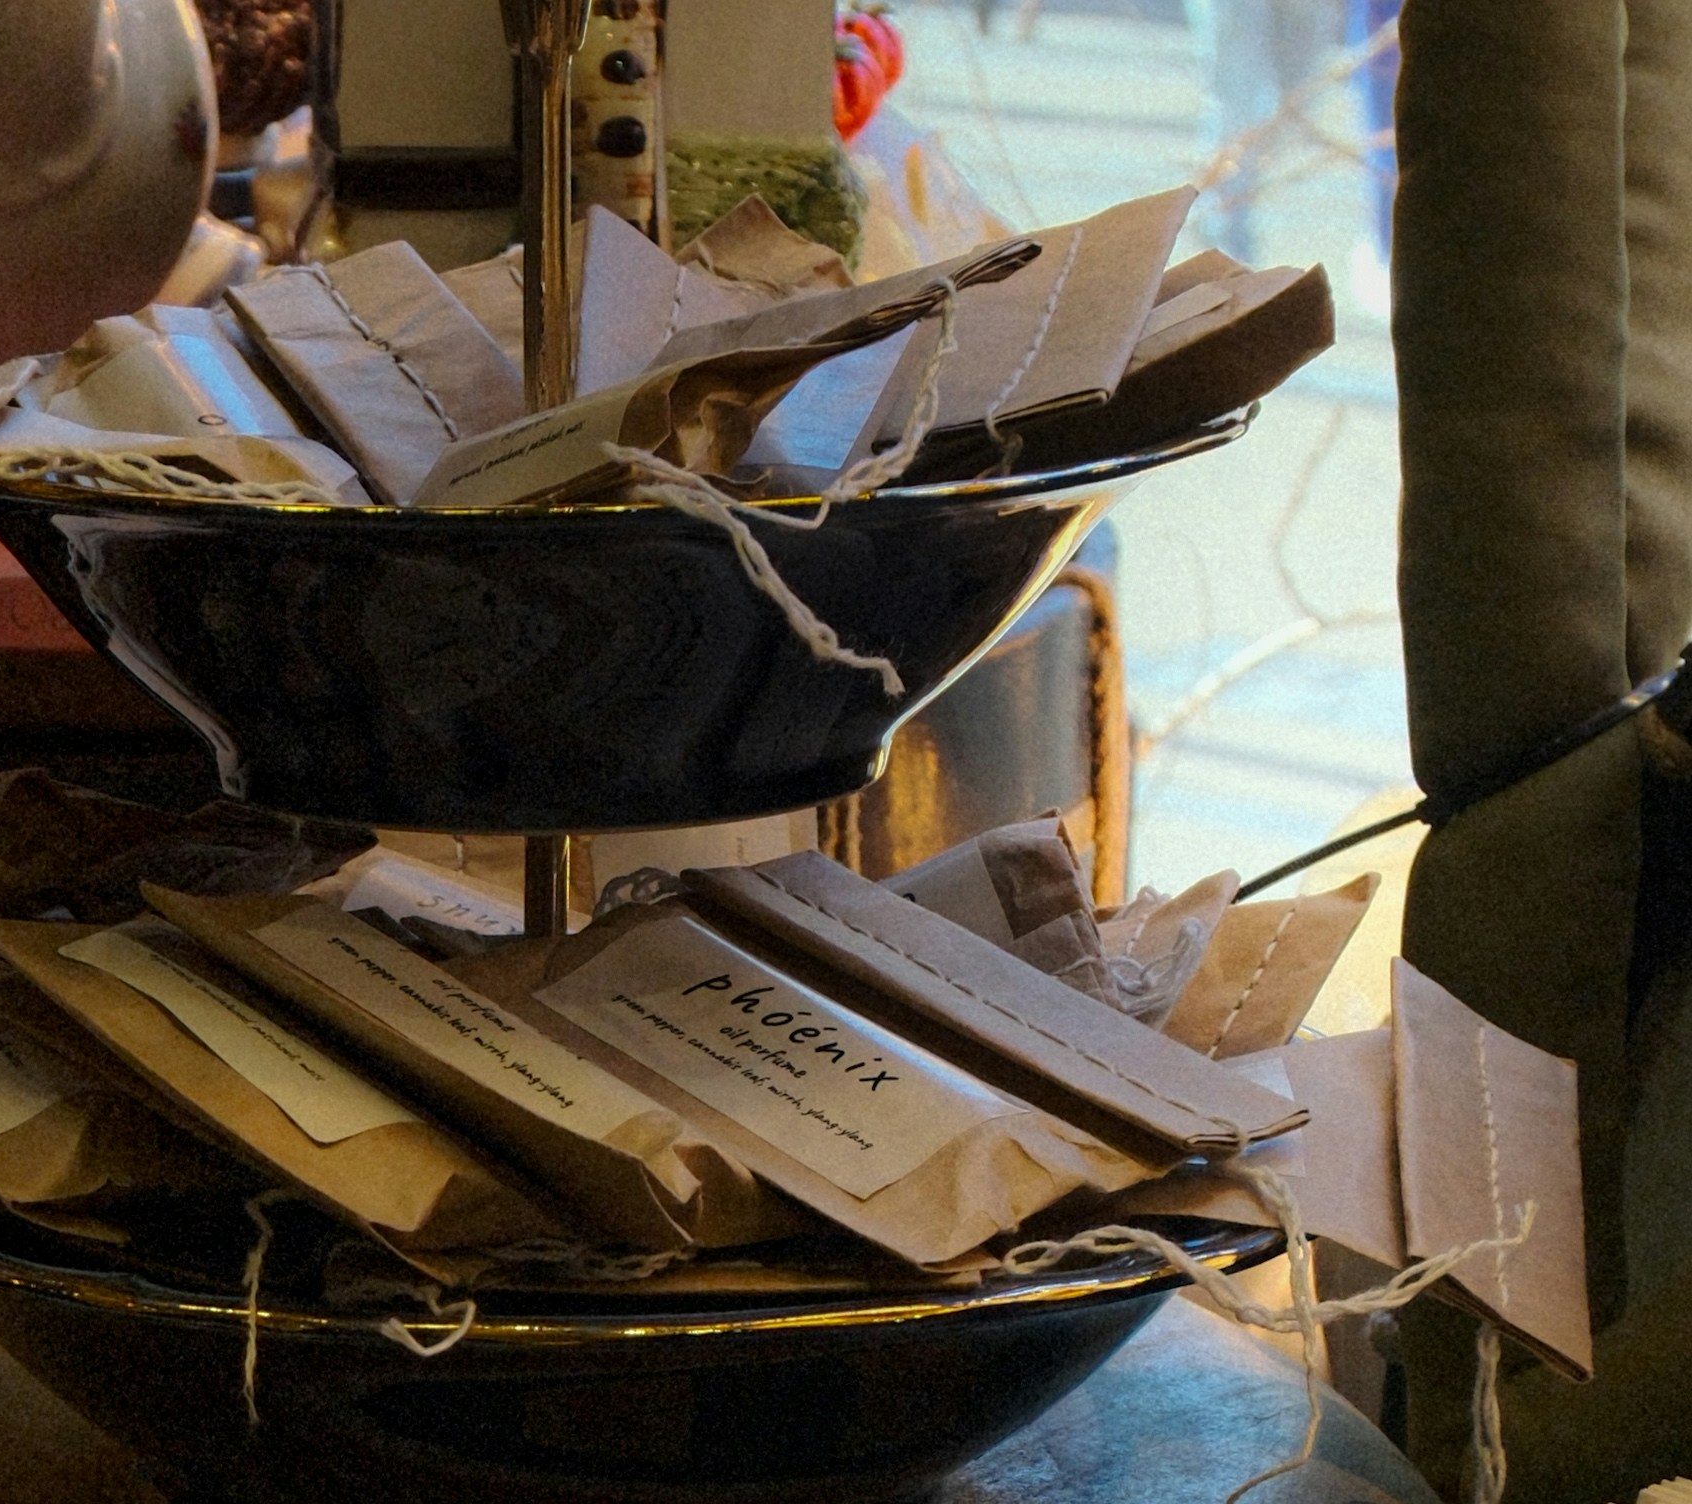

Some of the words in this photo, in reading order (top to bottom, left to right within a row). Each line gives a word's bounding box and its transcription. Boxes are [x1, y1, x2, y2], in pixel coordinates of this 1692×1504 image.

[445, 988, 516, 1033] perfume
[611, 993, 646, 1017] green
[687, 1036, 742, 1072] cannabis
[802, 1106, 874, 1152] ylang-ylang
[719, 1024, 743, 1045] oil
[739, 1036, 808, 1080] perfume
